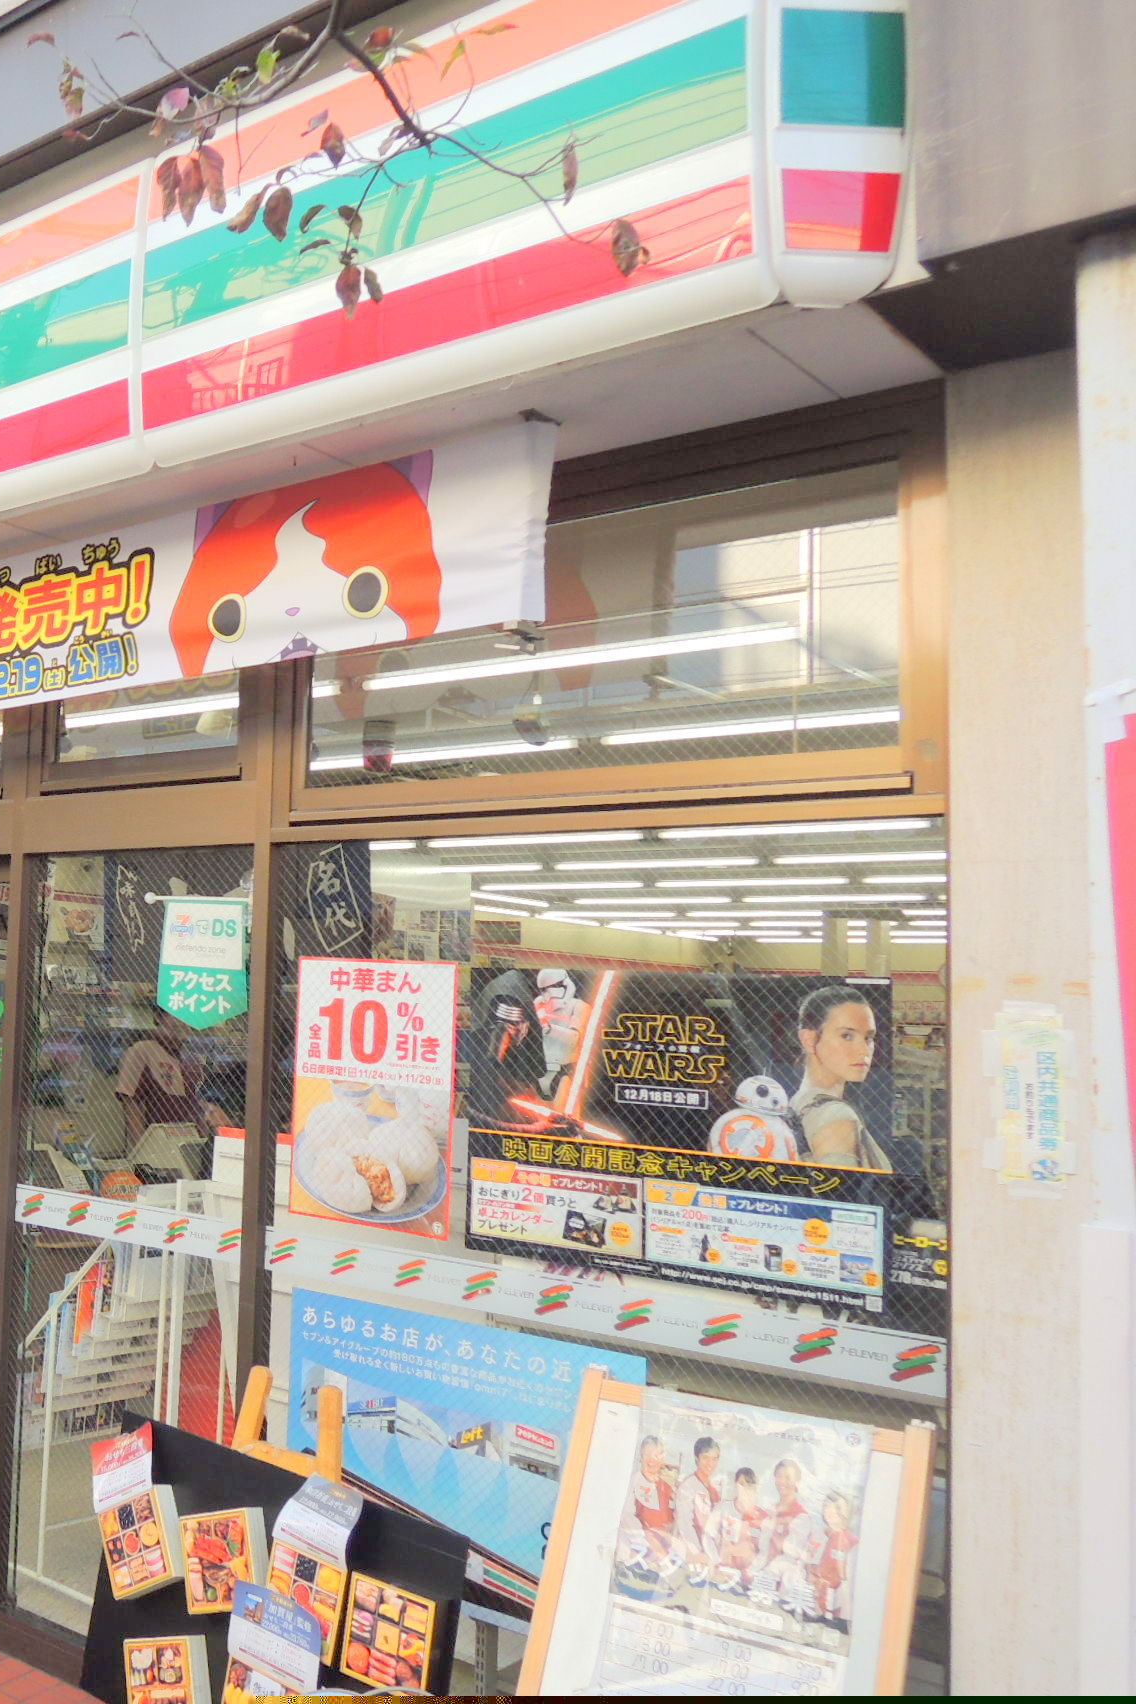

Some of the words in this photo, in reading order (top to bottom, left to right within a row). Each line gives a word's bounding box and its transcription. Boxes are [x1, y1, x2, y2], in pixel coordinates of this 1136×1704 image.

[212, 918, 238, 937] DS
[170, 970, 233, 992] アクセス
[330, 967, 422, 995] 中華まん
[168, 991, 232, 1015] ポイント
[307, 1023, 323, 1059] 全品
[319, 997, 389, 1065] 10
[602, 1013, 726, 1046] STAR
[396, 1033, 441, 1064] 引き
[602, 1049, 726, 1083] WARS
[624, 1088, 700, 1106] 12月18日公開
[503, 1138, 841, 1193] 映画公開記念キャンペーン
[478, 1185, 578, 1209] おにぎり2個買うと
[478, 1207, 555, 1225] 卓上カレンダー
[478, 1219, 528, 1235] プレゼント
[461, 1425, 485, 1444] Loft
[626, 1542, 835, 1620] スタッフ募集!
